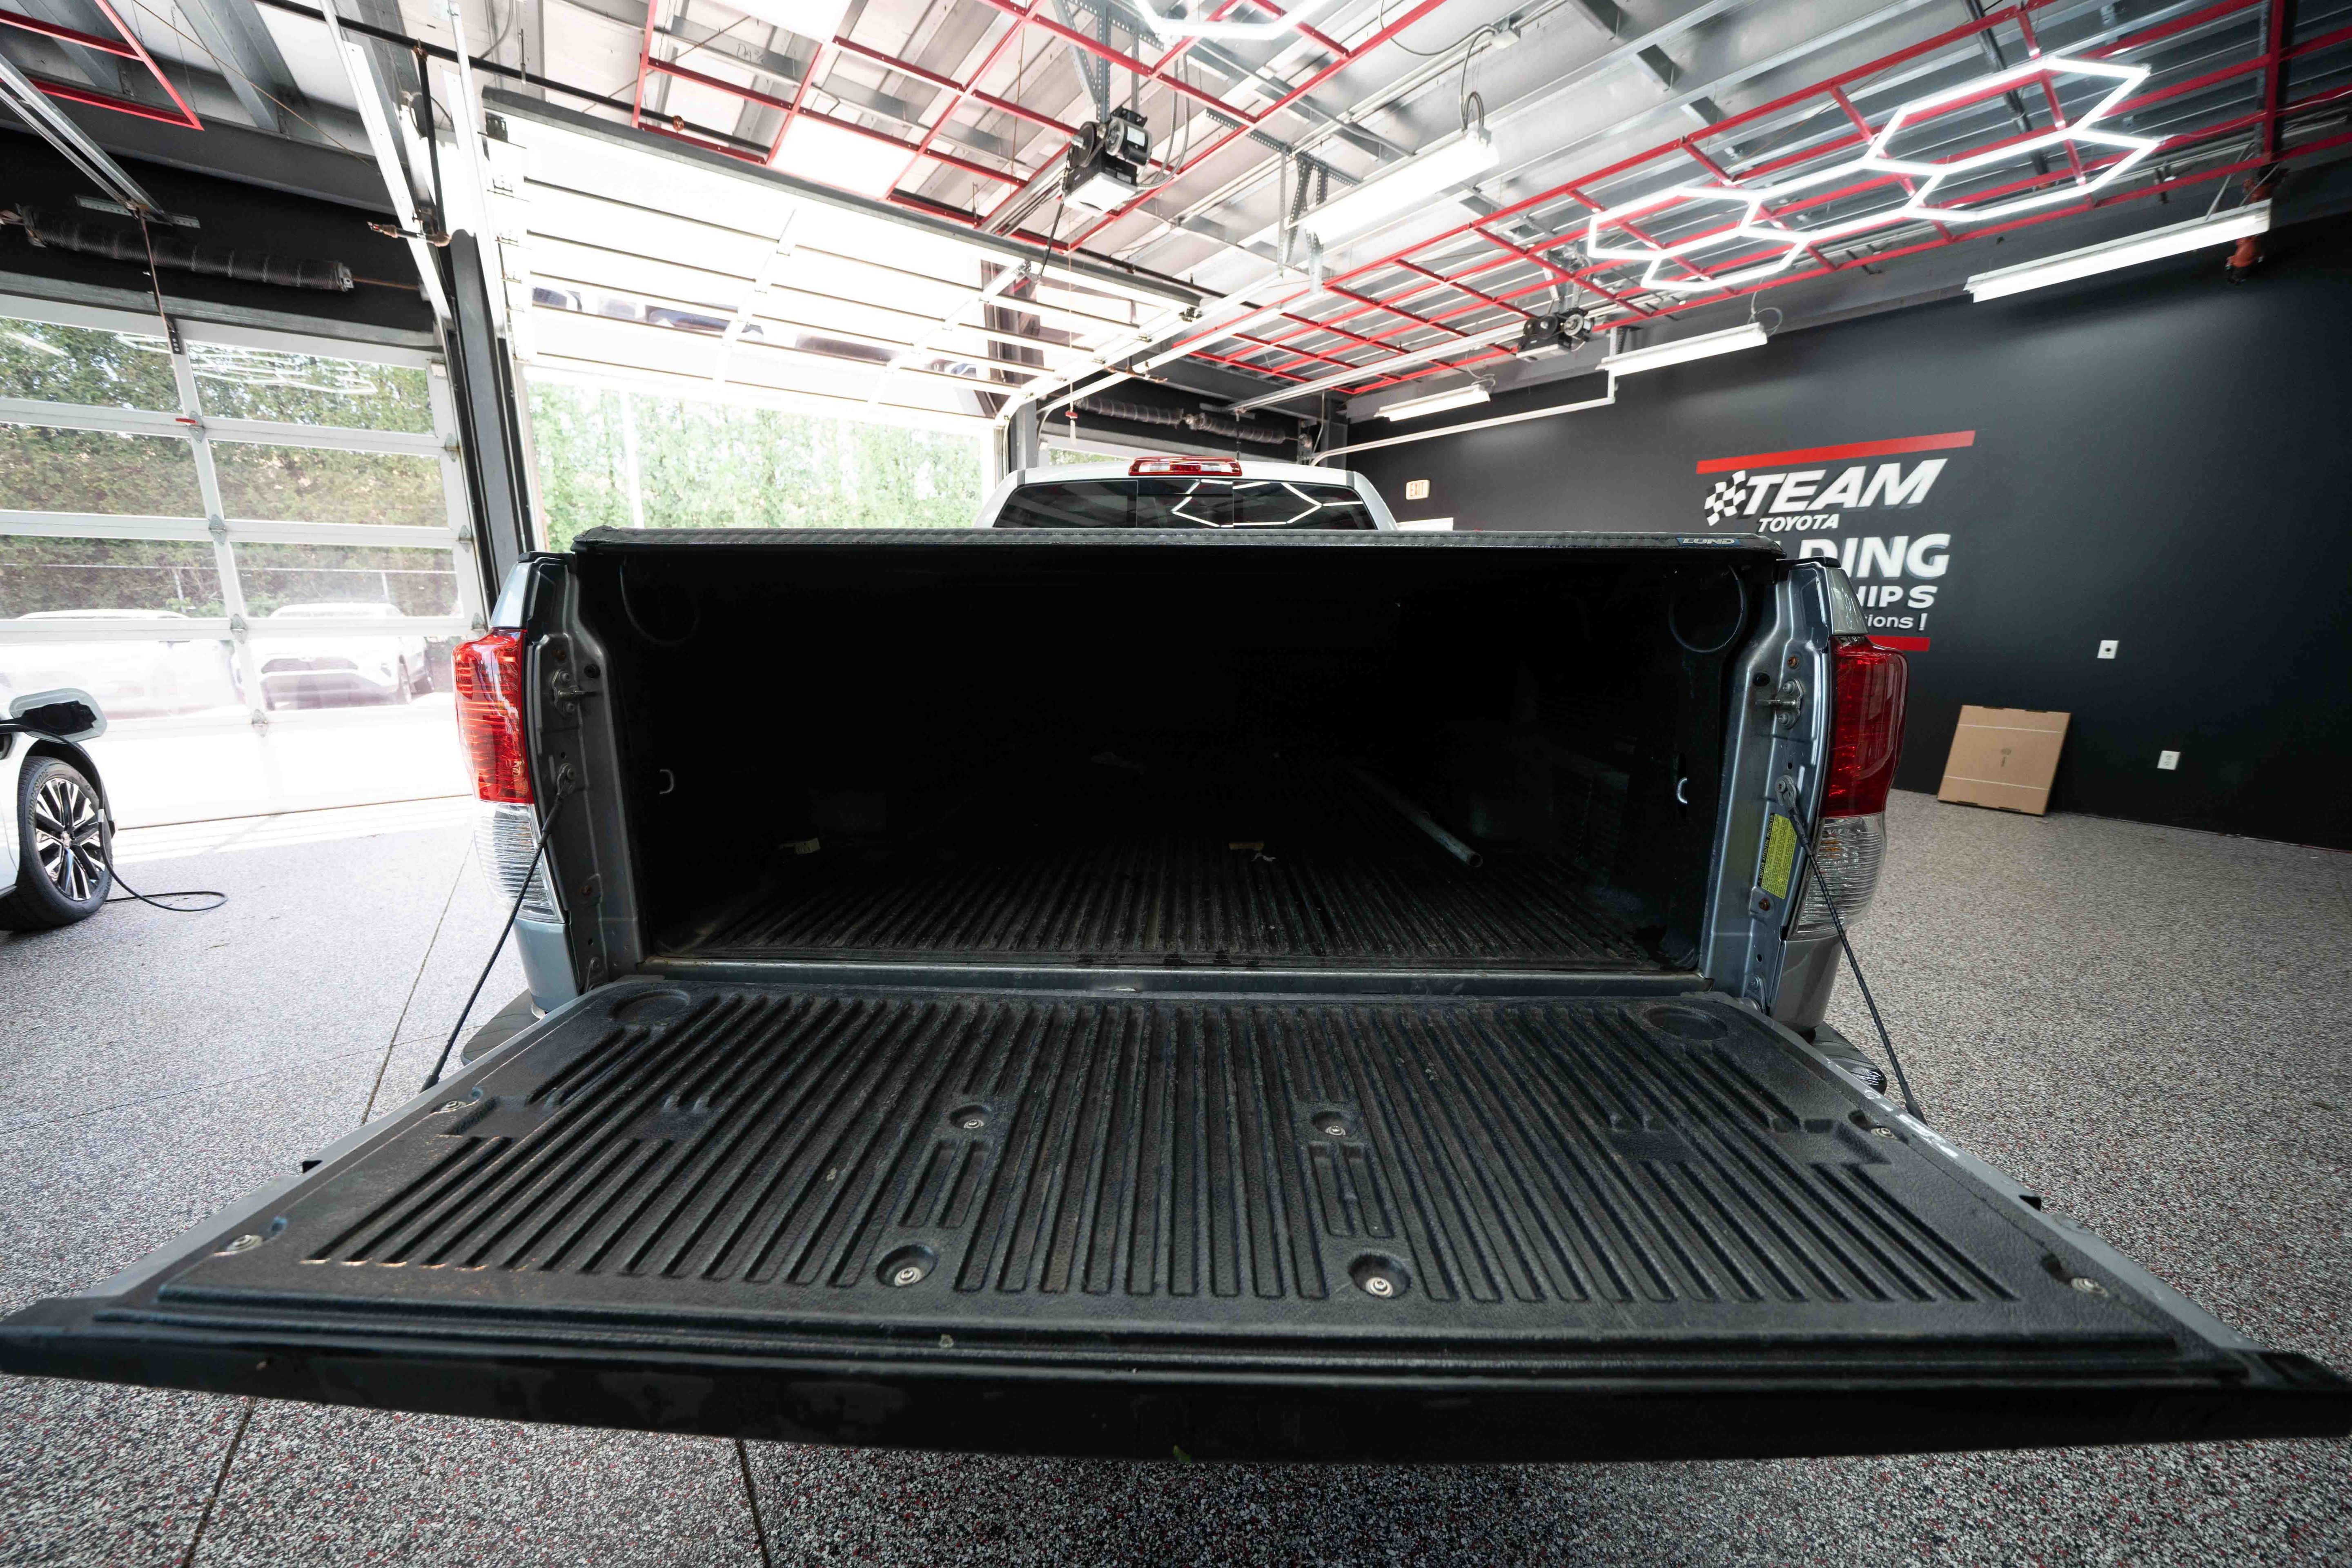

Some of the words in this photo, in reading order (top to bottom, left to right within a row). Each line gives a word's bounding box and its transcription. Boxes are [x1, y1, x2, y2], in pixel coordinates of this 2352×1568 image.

[1410, 482, 1424, 497] EXIT
[1743, 459, 1948, 514] TEAM
[1758, 513, 1840, 532] TOYOTA
[1774, 534, 1951, 578] DING
